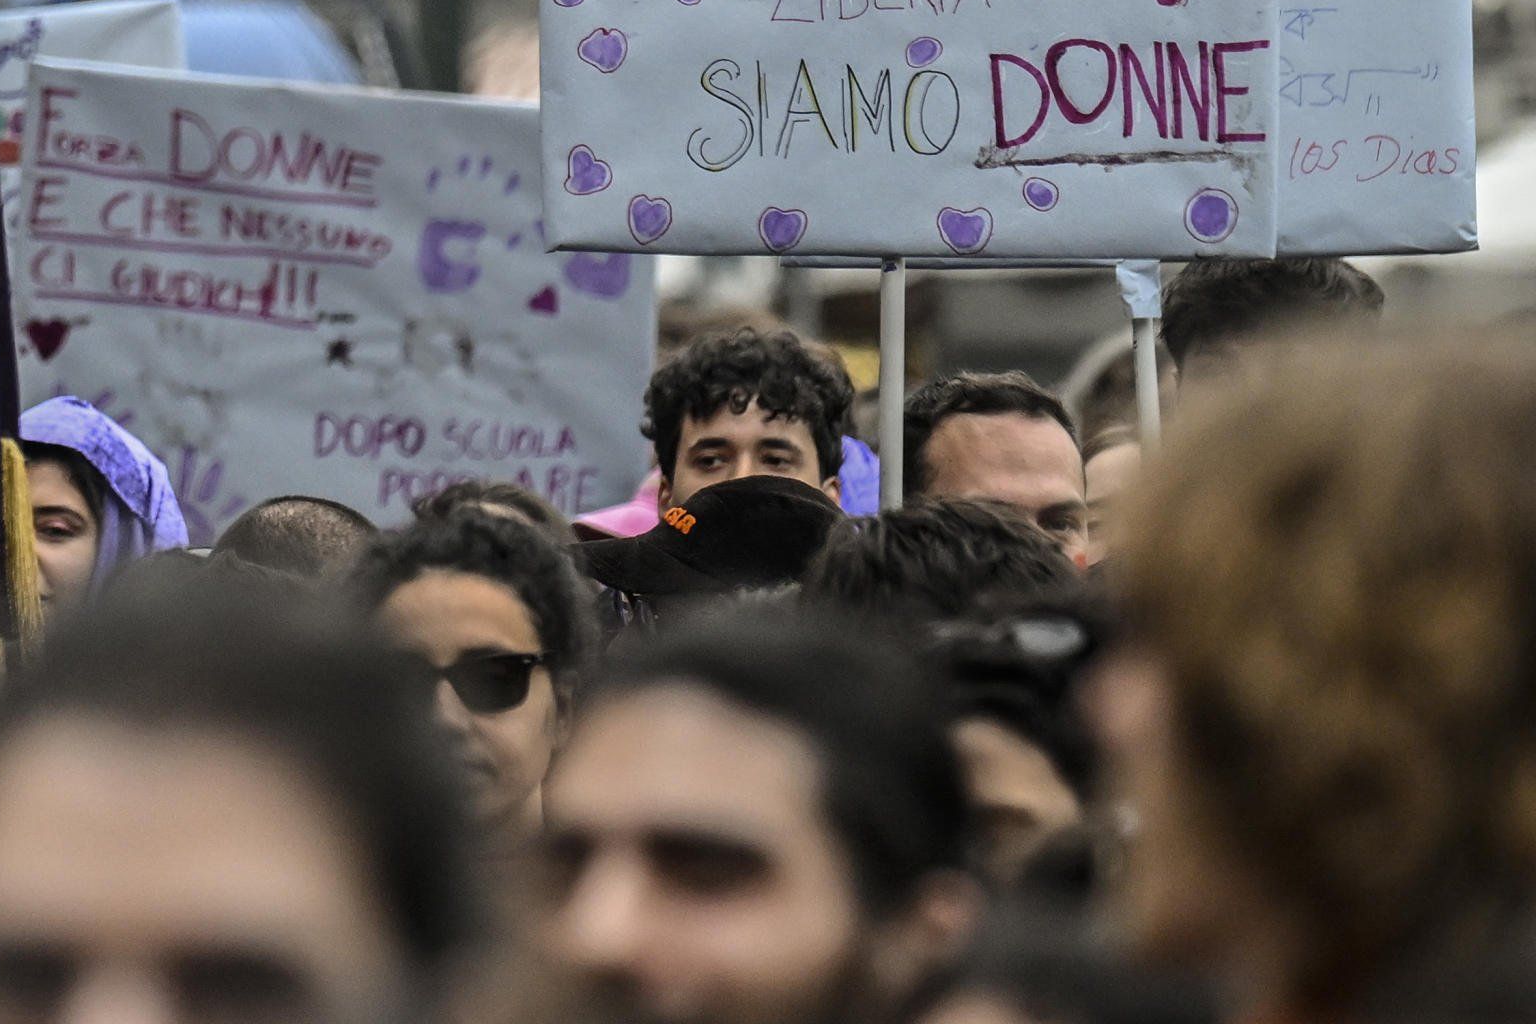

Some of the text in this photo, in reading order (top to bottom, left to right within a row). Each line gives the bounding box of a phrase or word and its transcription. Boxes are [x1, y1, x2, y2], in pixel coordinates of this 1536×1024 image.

[686, 39, 1271, 173] SIAMO DONNE
[170, 108, 385, 193] DONNE
[100, 188, 204, 239] CHE
[220, 203, 393, 260] NESSUNO
[30, 245, 77, 286] CI
[316, 412, 577, 461] DOPO SCUOLA
